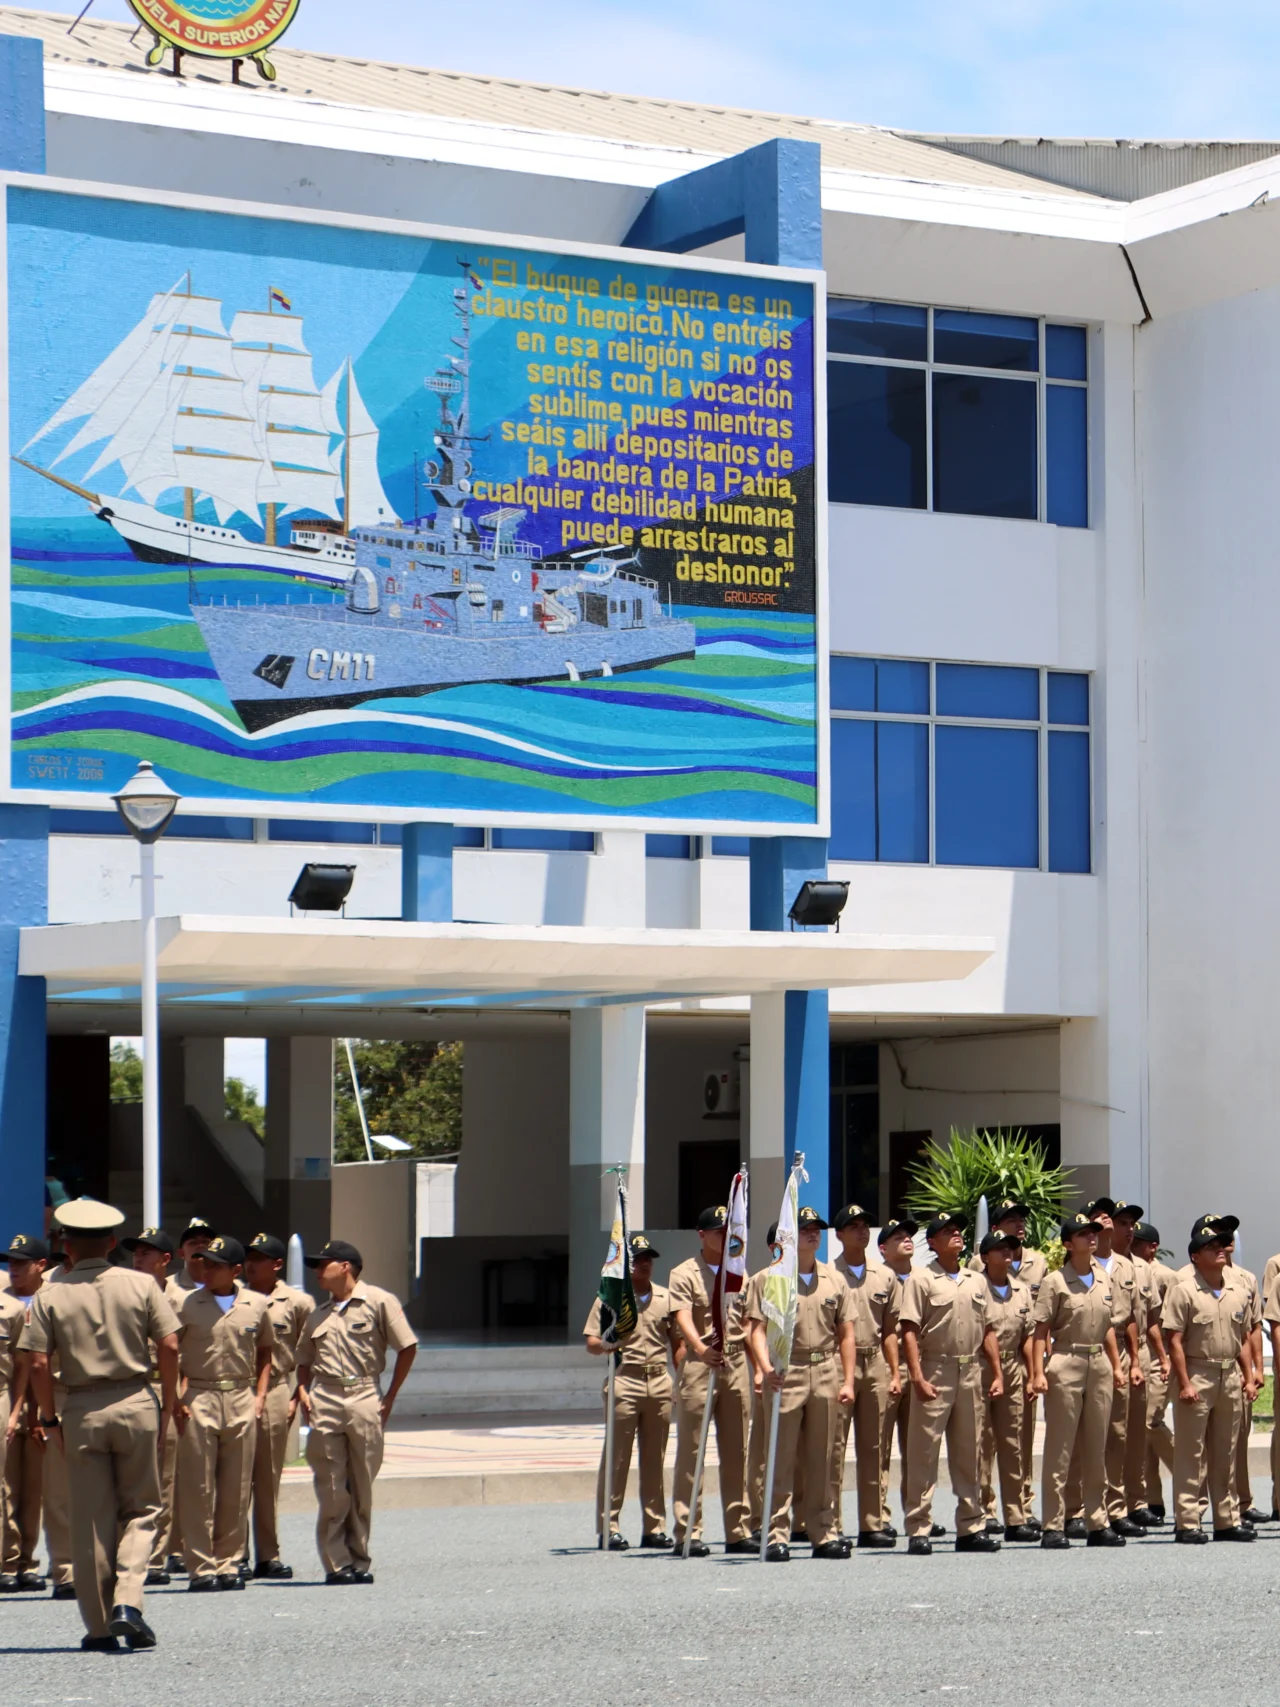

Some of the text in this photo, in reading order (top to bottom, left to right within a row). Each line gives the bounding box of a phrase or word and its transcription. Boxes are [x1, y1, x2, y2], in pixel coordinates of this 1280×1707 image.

[184, 20, 270, 46] SUPERIOR
[527, 262, 599, 302] buque
[609, 274, 636, 302] de
[646, 284, 719, 312] guerra
[728, 293, 755, 315] es
[764, 298, 792, 320] un
[471, 288, 568, 325] claustro
[713, 318, 793, 350] entréis
[516, 330, 793, 380] en esa religión si no os
[526, 361, 793, 409] sentís con la vocación
[501, 416, 793, 469] seáis allí depositarios de
[631, 403, 688, 431] pues
[694, 406, 793, 439] mientras
[527, 447, 798, 505] la bandera de la Patria,
[472, 477, 795, 529] cualquier debilidad humana
[561, 517, 794, 558] puede arrastraros al
[724, 590, 779, 605] GROUSSAC
[306, 648, 376, 681] CM11
